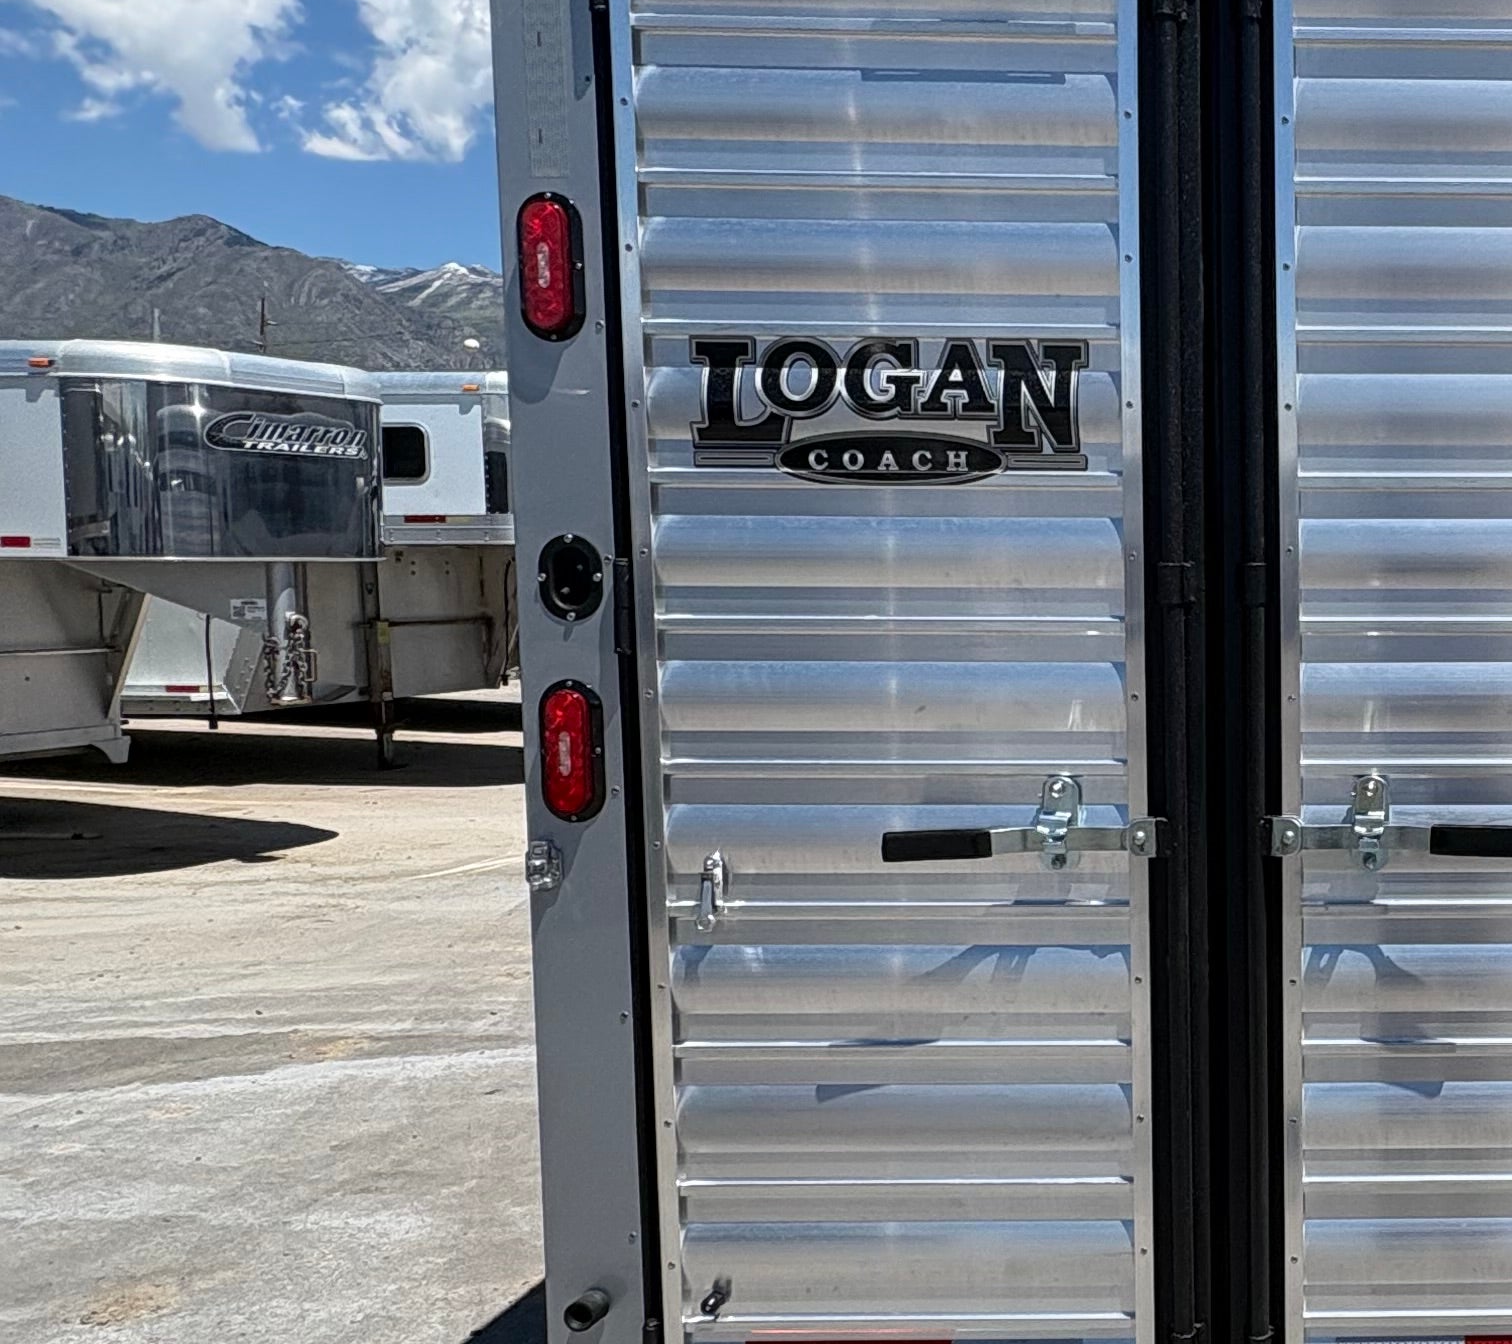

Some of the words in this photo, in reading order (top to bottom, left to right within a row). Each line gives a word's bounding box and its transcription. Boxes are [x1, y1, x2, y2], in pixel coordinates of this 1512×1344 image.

[690, 336, 1089, 452] LOGAN
[204, 411, 367, 450] Cimarron
[241, 440, 360, 456] TRAILERS
[807, 449, 969, 471] COACH
